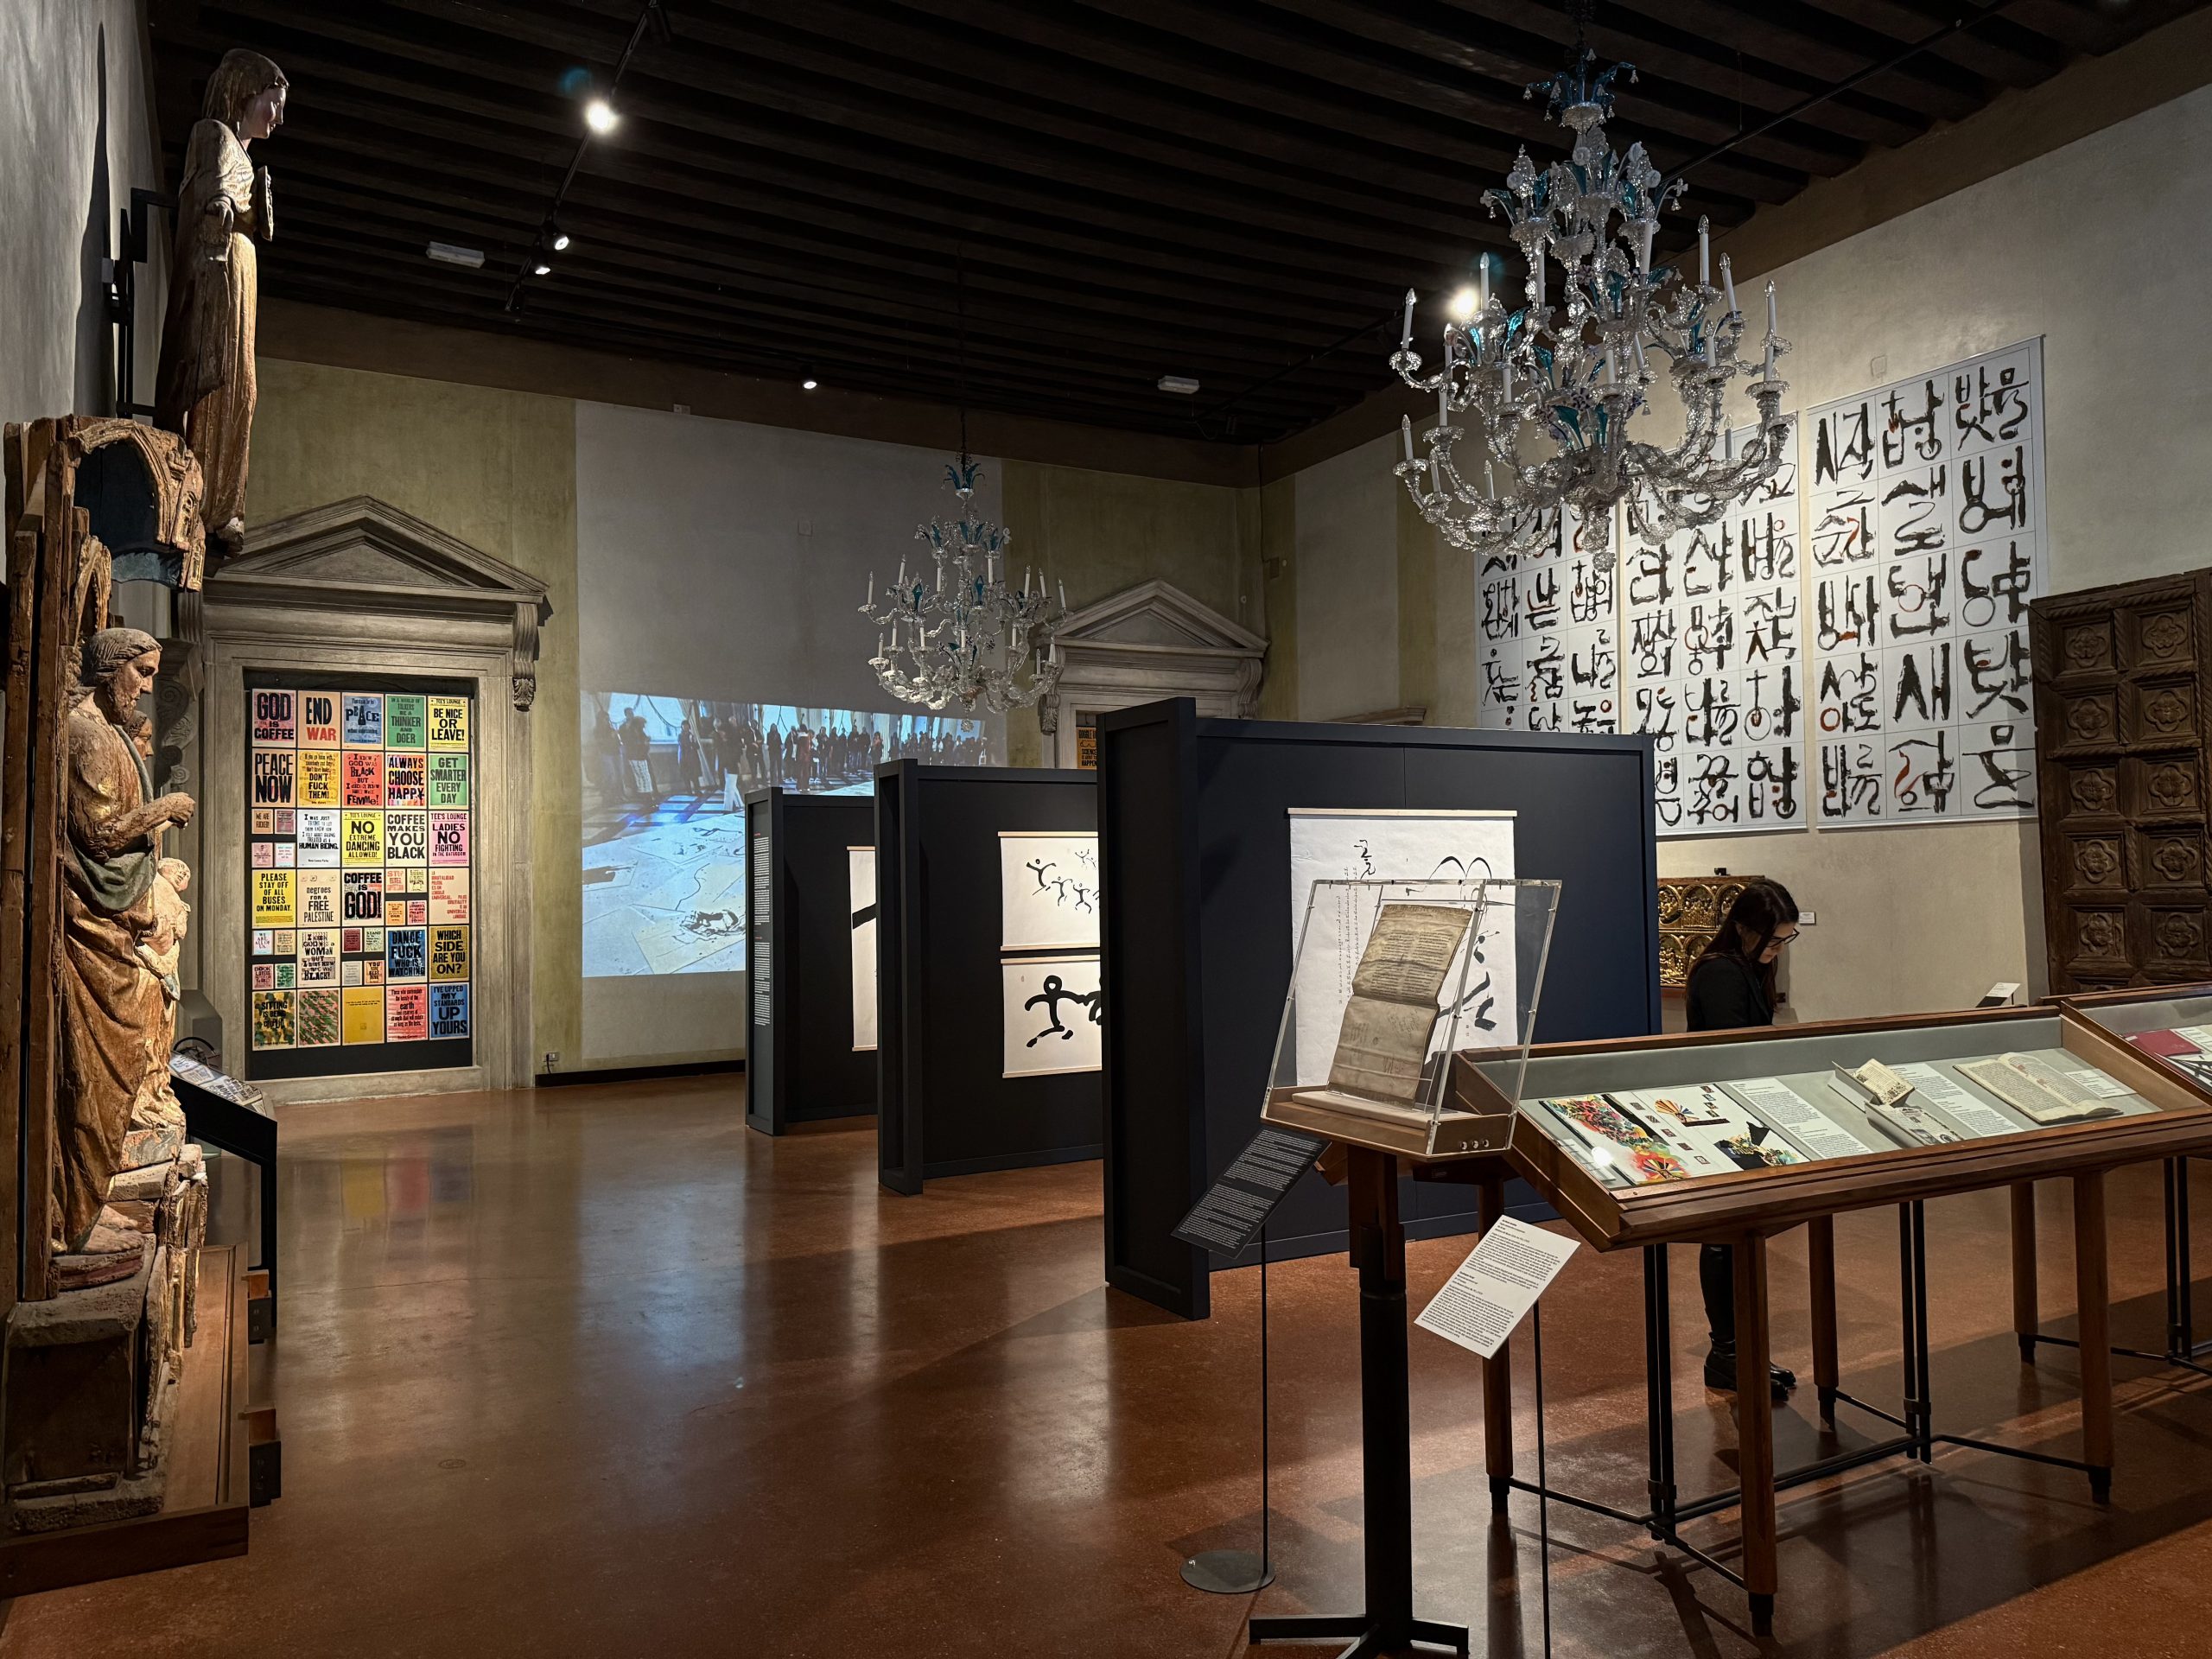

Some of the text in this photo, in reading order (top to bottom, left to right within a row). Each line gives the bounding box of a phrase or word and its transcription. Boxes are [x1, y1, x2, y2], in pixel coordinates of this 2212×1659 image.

[257, 692, 291, 721] GOD
[306, 696, 332, 725] END
[346, 705, 379, 725] PEACE
[434, 709, 462, 719] BE NICE
[391, 716, 421, 727] THINKER
[439, 719, 457, 728] OR
[254, 728, 294, 741] COFFEE
[307, 727, 336, 741] WAR
[397, 734, 416, 743] DOER
[432, 728, 465, 741] LEAVE!
[255, 753, 293, 775] PEACE
[389, 756, 423, 769] ALWAYS
[438, 758, 458, 768] GET
[351, 766, 375, 777] BLACK
[430, 769, 467, 781] SMARTER
[389, 771, 423, 786] CHOOSE
[256, 775, 292, 803] NOW
[308, 782, 328, 791] FUCK
[436, 782, 461, 792] EVERY
[308, 791, 329, 799] THEM!
[388, 787, 424, 800] HAPPY
[441, 793, 457, 804] DAY
[387, 814, 425, 824] COFFEE
[351, 821, 374, 834] NO
[389, 833, 423, 845] YOU
[438, 831, 461, 844] NO
[346, 842, 380, 851] DANCING
[387, 847, 425, 859] BLACK
[344, 873, 382, 883] COFFEE
[308, 900, 329, 911] FREE
[345, 892, 382, 918] GOD!
[304, 912, 334, 922] PALESTINE
[392, 931, 421, 944] DANCE
[437, 930, 461, 940] WHICH
[391, 945, 422, 959] FUCK
[435, 941, 463, 951] SIDE
[433, 952, 465, 963] ARE YOU
[389, 968, 424, 976] WATCHING
[436, 963, 461, 974] ON?
[439, 1007, 460, 1020] UP
[432, 1020, 467, 1035] YOURS
